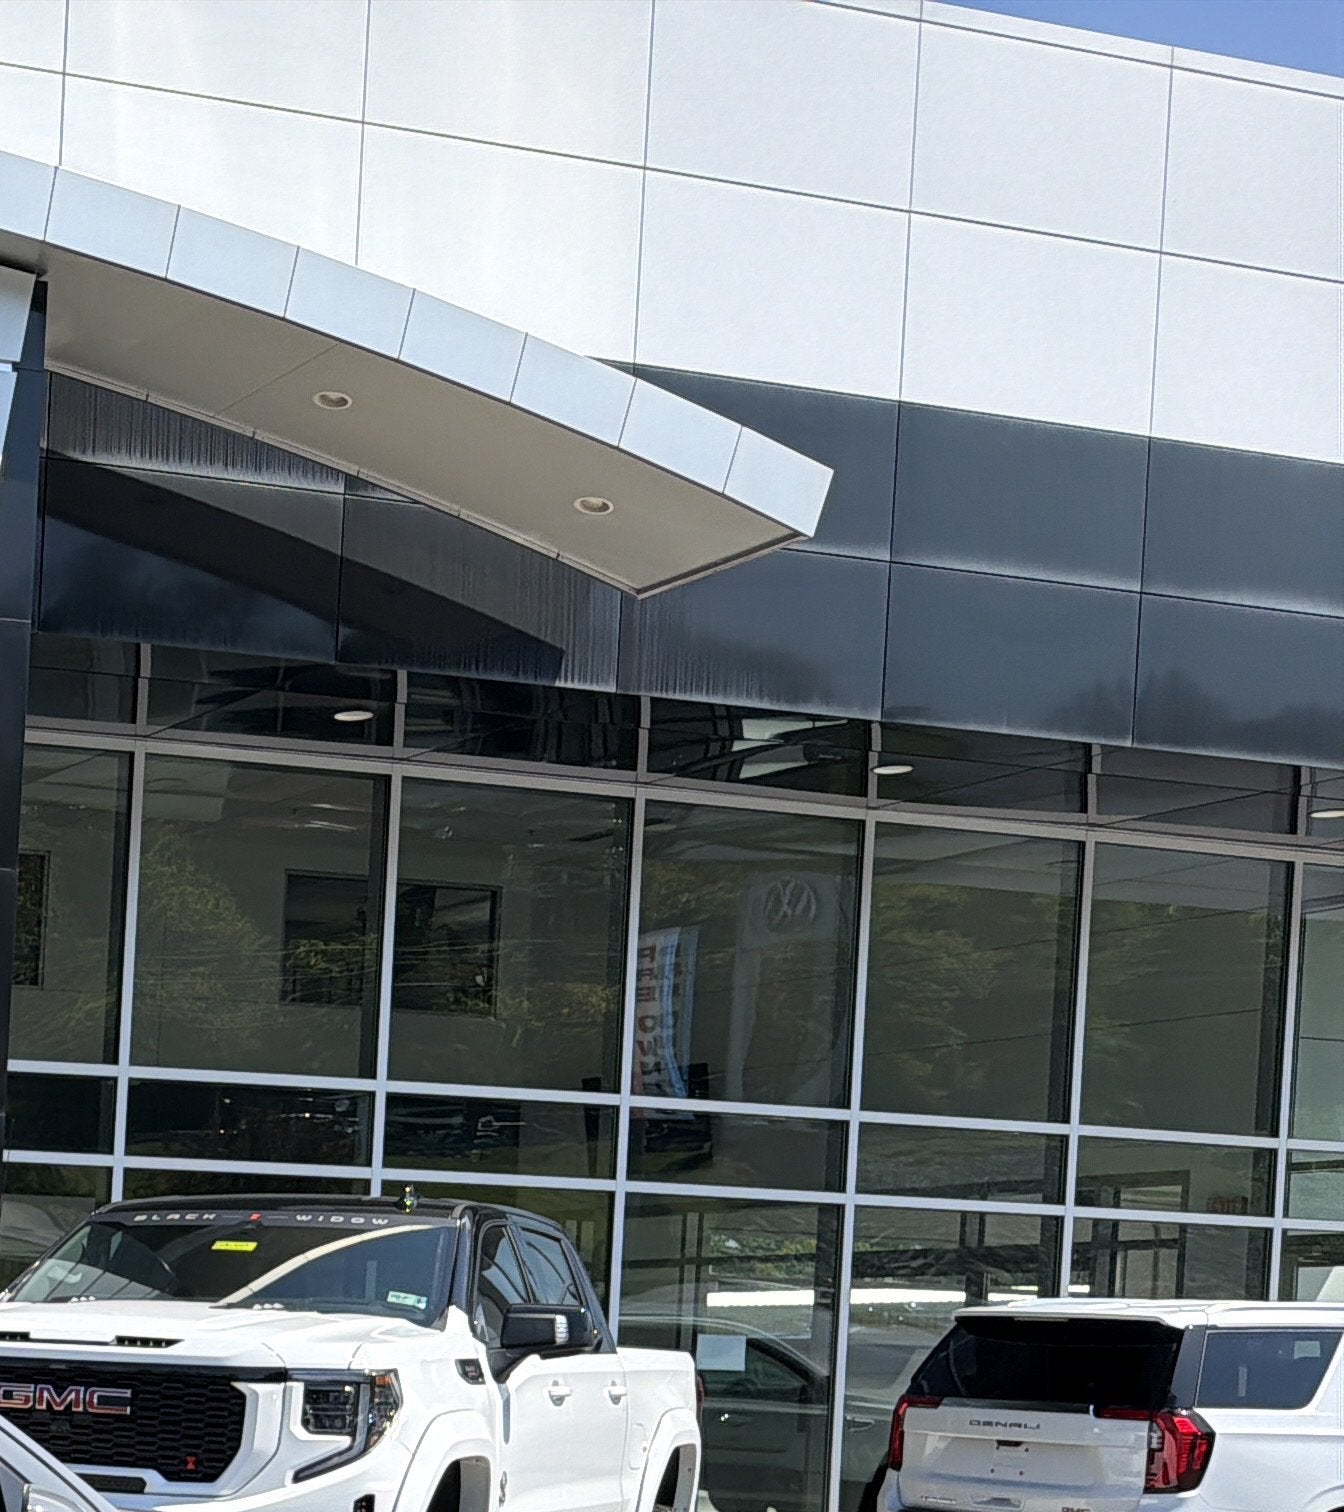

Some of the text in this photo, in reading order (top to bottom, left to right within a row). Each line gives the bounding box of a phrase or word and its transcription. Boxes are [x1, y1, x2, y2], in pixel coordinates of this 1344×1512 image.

[133, 1212, 390, 1226] BLACK WIDOW
[969, 1419, 1040, 1430] DENALI
